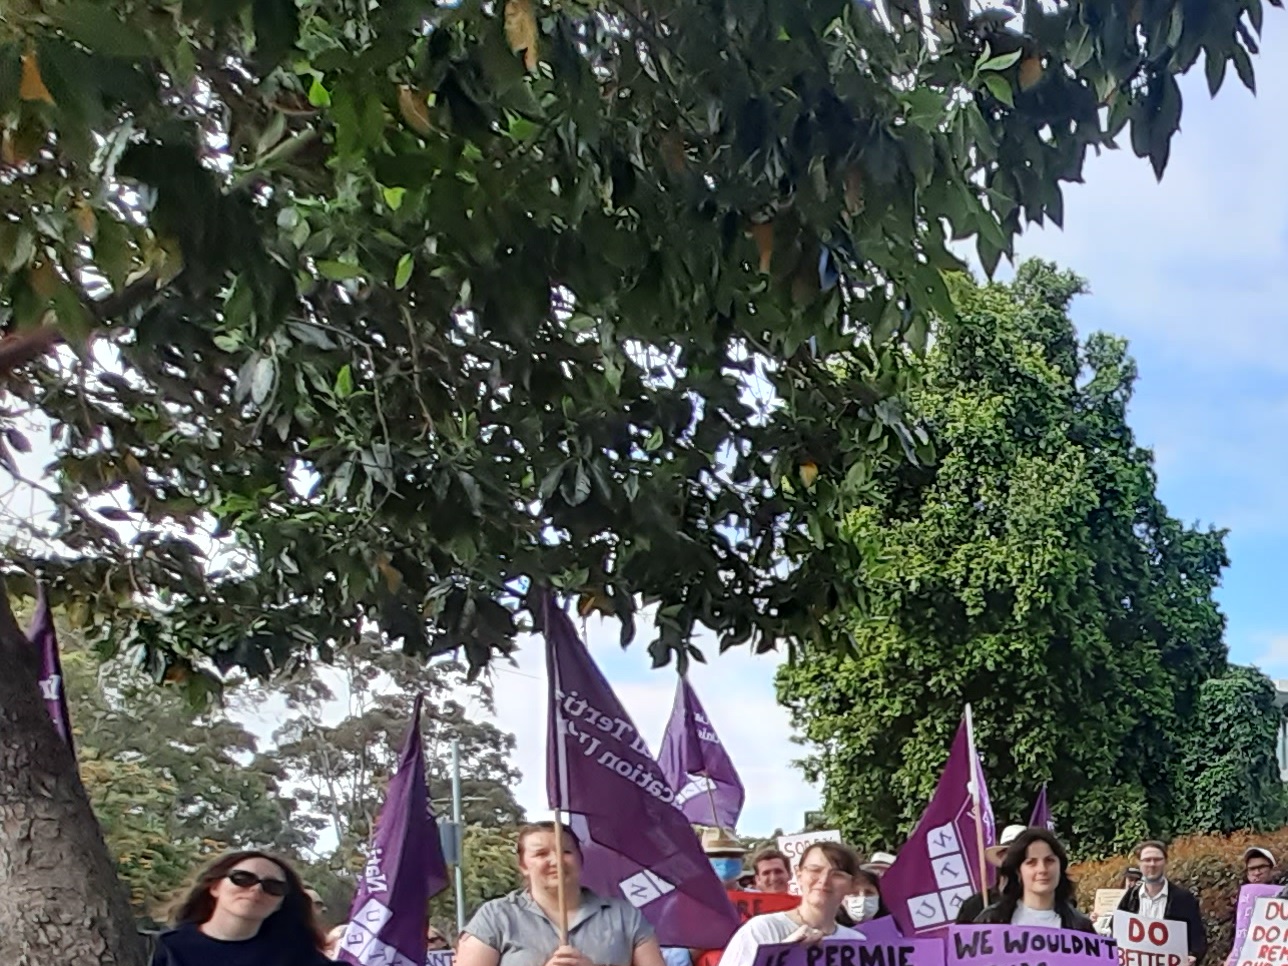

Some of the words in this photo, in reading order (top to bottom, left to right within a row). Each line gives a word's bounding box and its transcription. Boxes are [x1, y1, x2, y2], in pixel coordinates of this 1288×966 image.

[953, 930, 994, 960] WE
[1003, 930, 1118, 960] WOULDN'T
[1129, 917, 1168, 946] DO
[1252, 925, 1280, 943] DO
